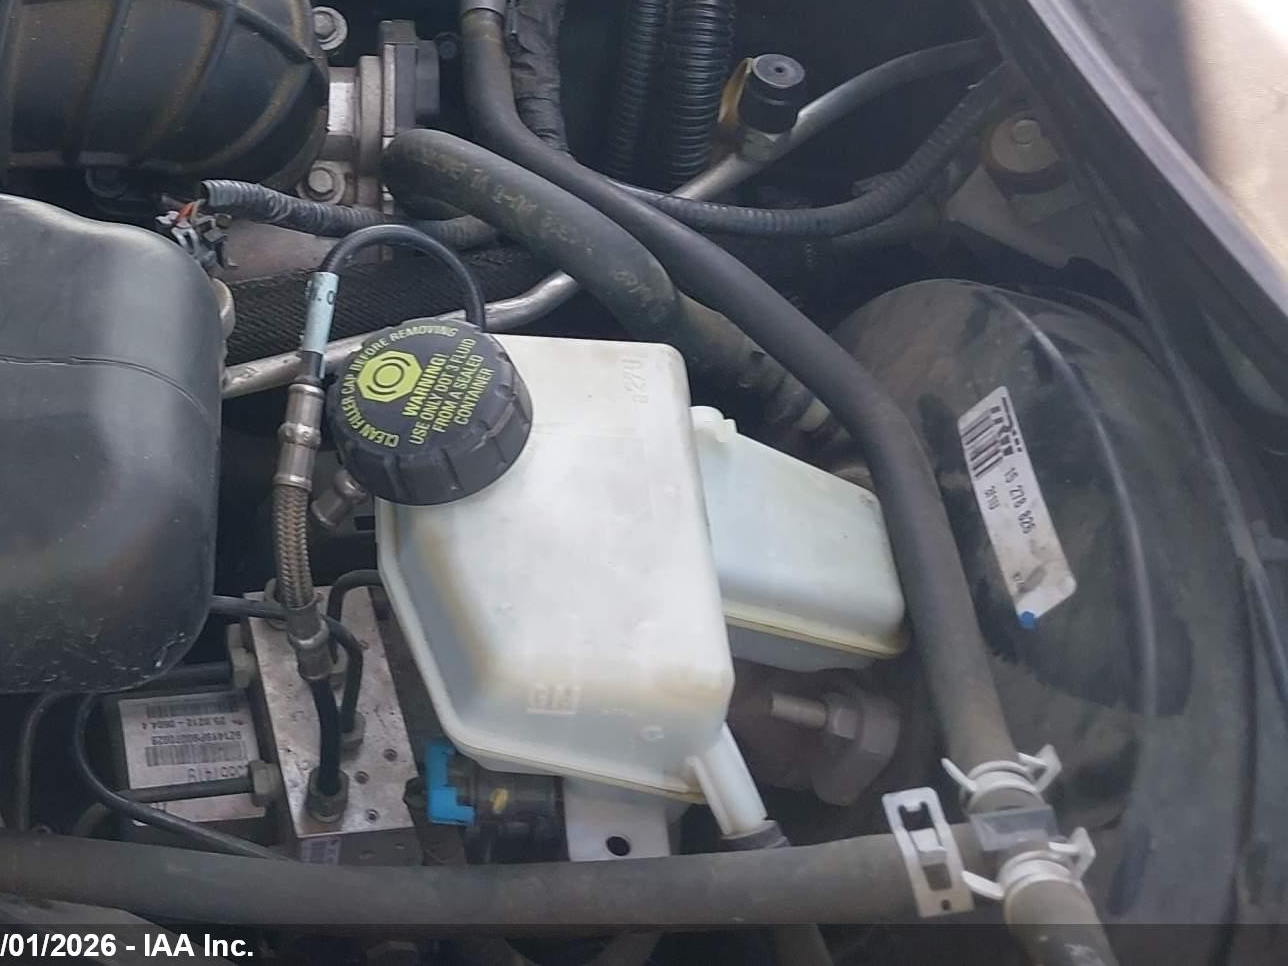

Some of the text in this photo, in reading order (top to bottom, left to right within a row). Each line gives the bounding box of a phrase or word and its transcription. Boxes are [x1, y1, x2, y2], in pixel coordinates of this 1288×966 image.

[341, 324, 459, 448] CLEAN FILLER CAP BEFORE REMOVING
[402, 353, 450, 416] WARNING!
[408, 338, 477, 445] USE ONLY DOT 3 FLUID
[431, 354, 484, 433] FROM A SEALED
[453, 368, 496, 425] CONTAINER
